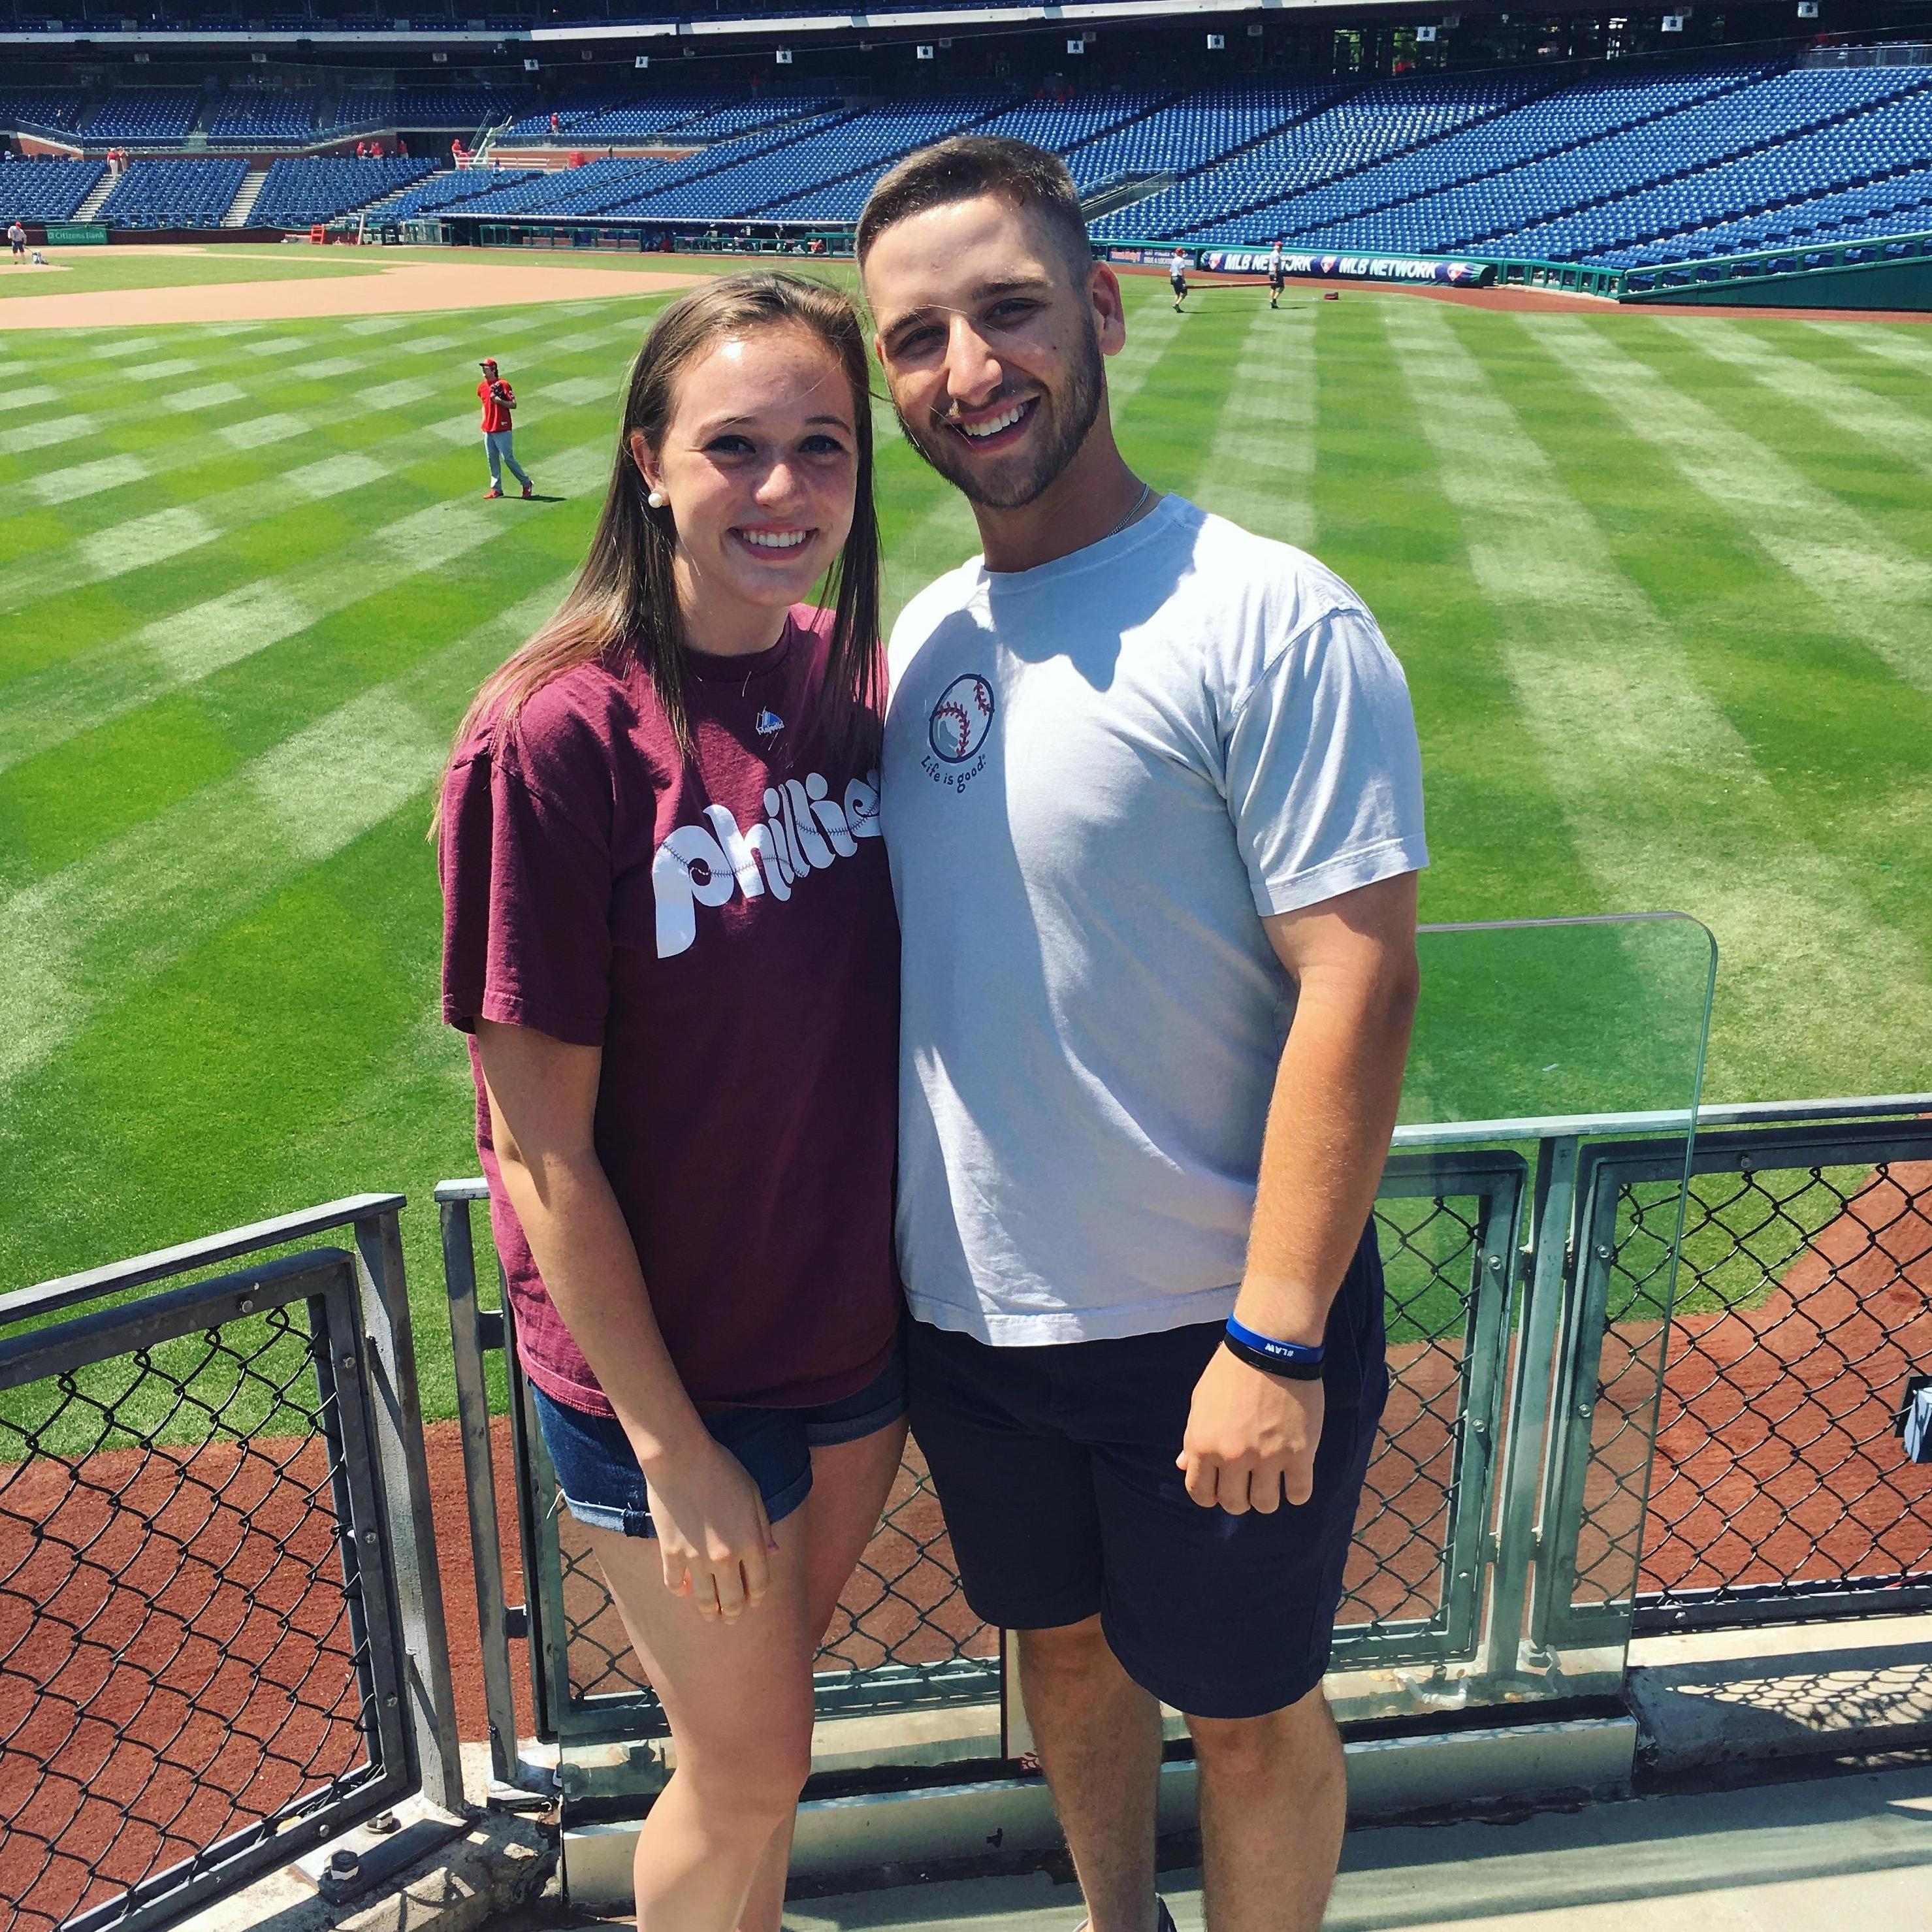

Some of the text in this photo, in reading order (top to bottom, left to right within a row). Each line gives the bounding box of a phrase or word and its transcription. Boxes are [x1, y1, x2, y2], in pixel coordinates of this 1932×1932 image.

[1224, 253, 1252, 270] MLB
[1339, 257, 1442, 279] MLB NETWORK
[920, 755, 941, 782] Life
[943, 773, 954, 785] is
[651, 771, 881, 959] phillie
[1264, 1343, 1295, 1358] #LAW
